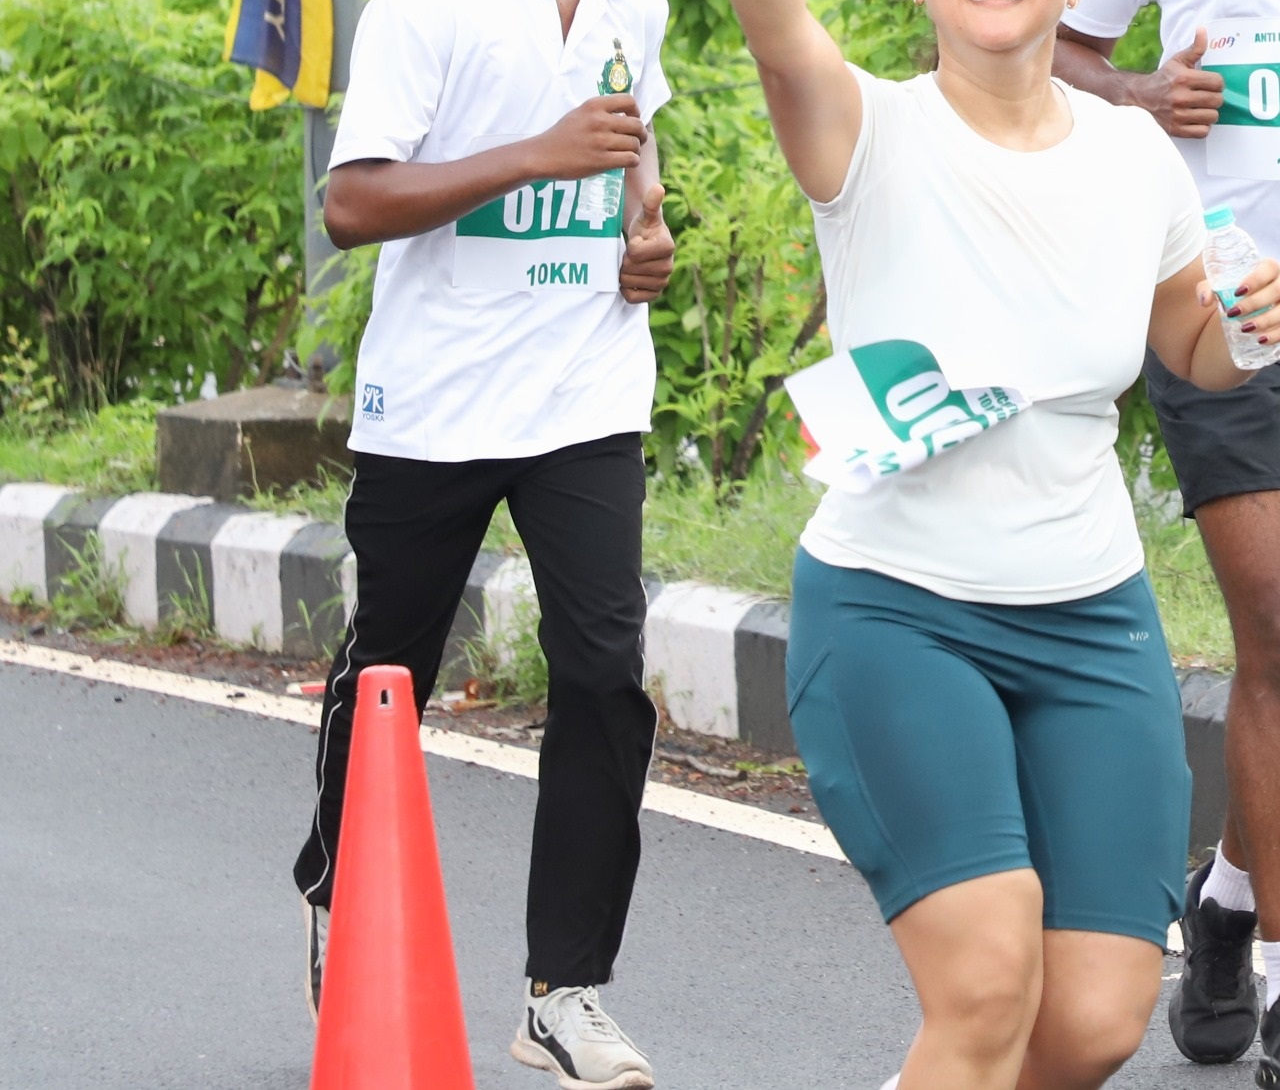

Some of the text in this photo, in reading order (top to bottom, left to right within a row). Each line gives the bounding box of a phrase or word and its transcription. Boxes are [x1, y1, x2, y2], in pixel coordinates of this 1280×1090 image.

[1254, 31, 1277, 43] ANTI
[526, 262, 589, 287] 10KM
[362, 412, 385, 422] YOSKA
